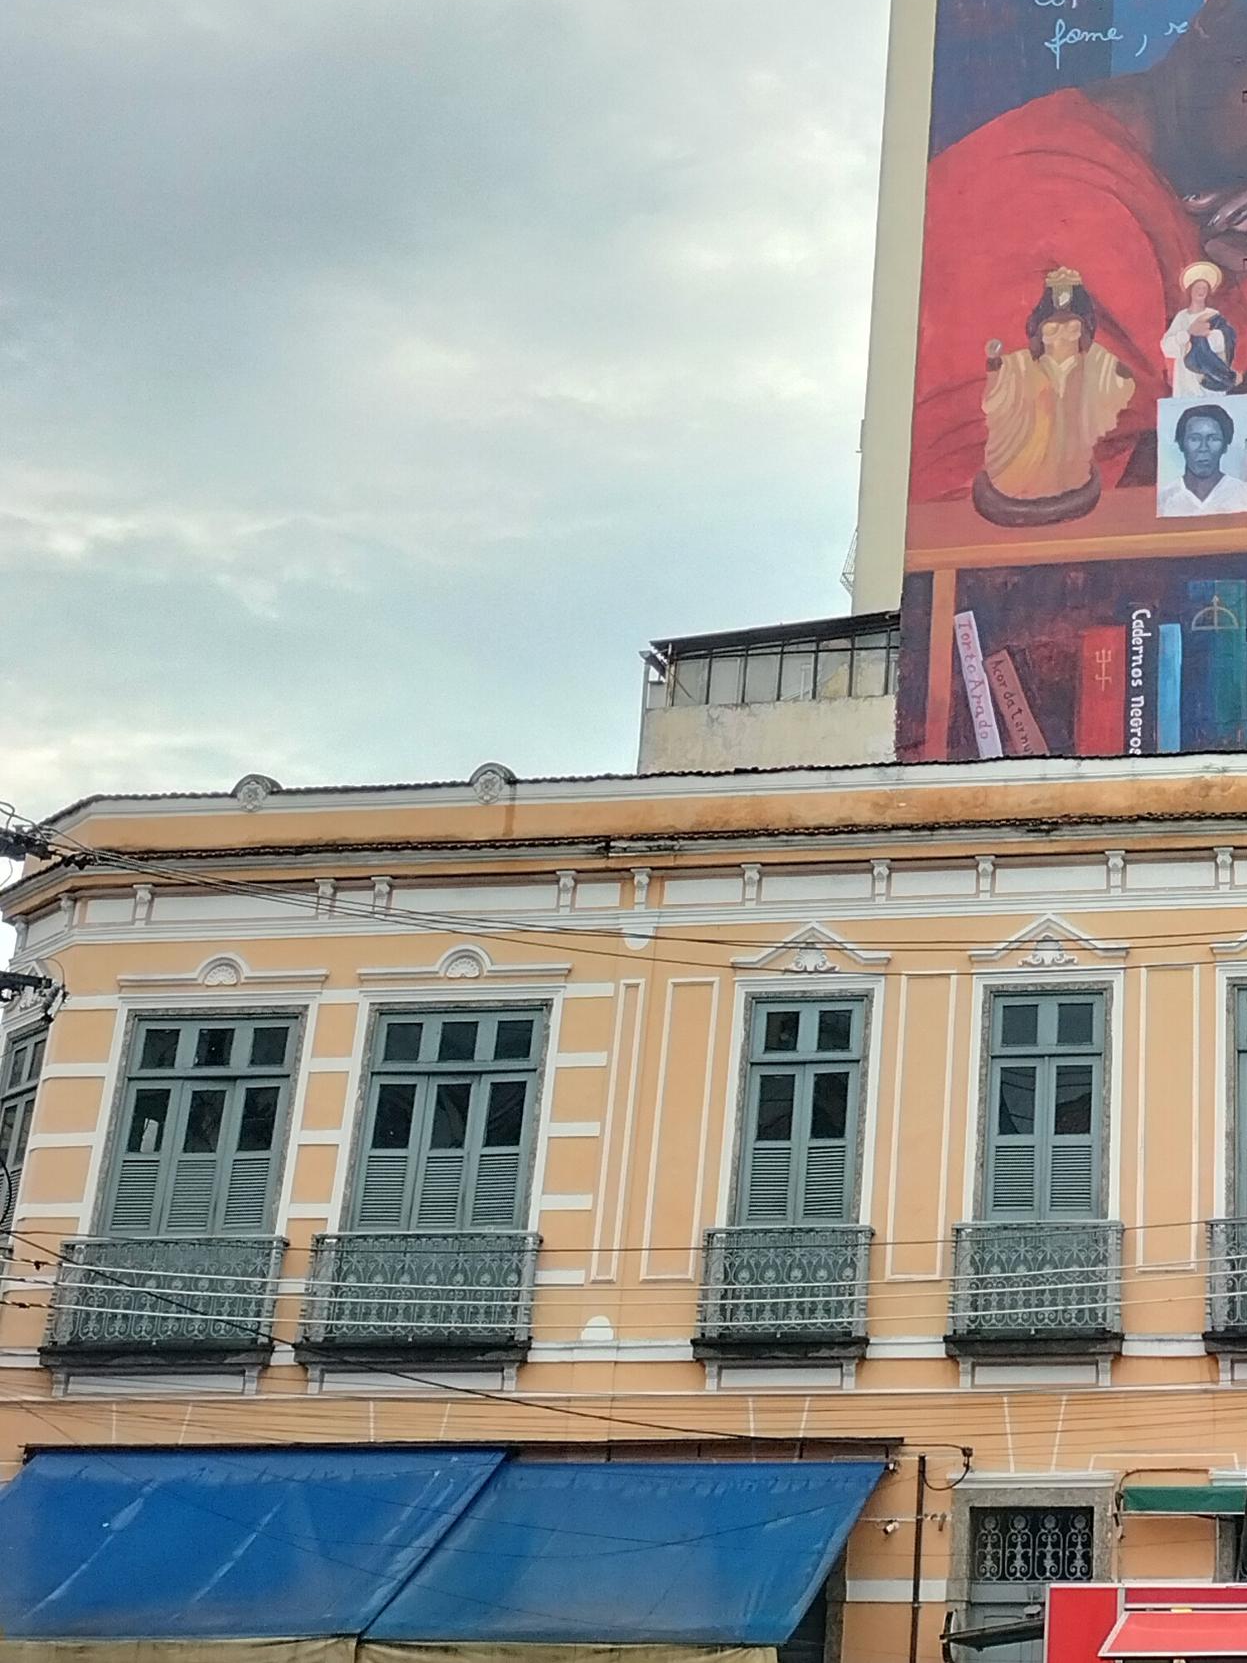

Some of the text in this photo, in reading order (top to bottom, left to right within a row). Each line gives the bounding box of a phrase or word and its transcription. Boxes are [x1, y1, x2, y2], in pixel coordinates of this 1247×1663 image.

[958, 620, 993, 740] Torto Arado
[1131, 609, 1151, 687] Cadernos
